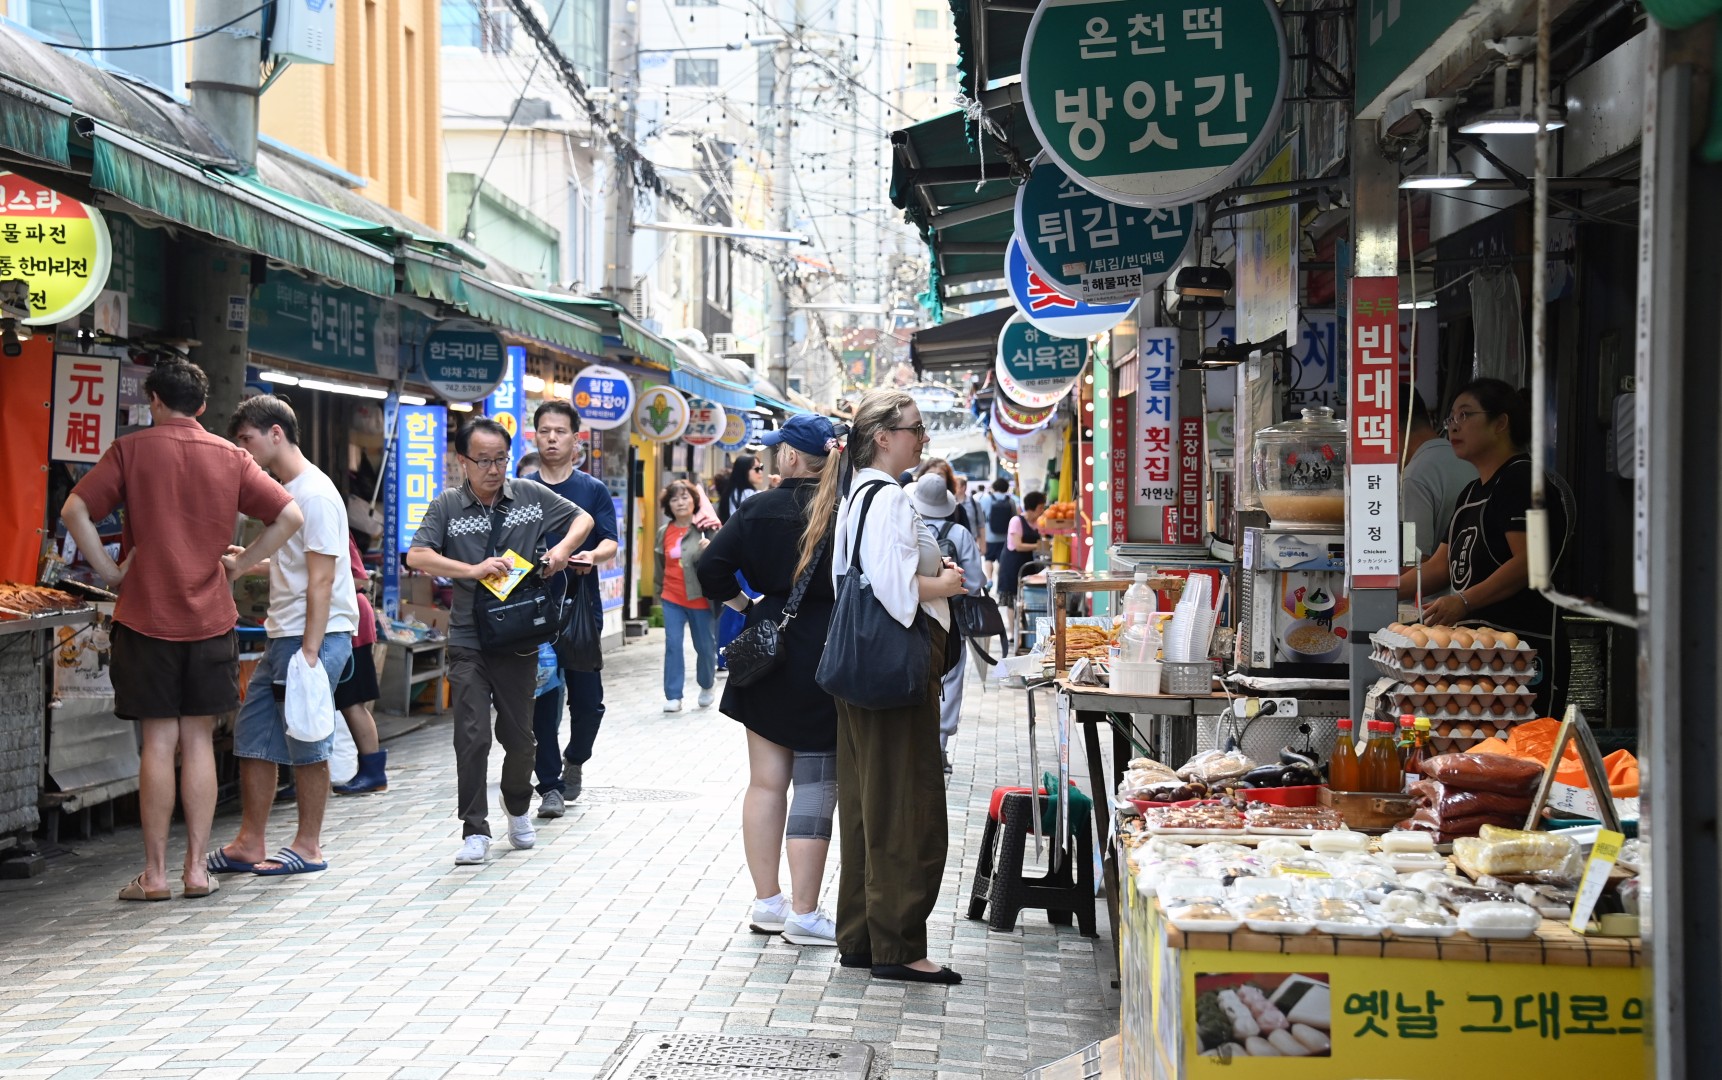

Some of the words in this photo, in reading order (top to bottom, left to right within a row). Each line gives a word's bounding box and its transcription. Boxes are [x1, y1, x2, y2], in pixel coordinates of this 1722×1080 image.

[1055, 73, 1253, 161] 방앗간
[18, 256, 88, 278] 한마리전
[1091, 274, 1142, 291] 해물파전
[311, 290, 366, 357] 한국마트
[1356, 297, 1395, 318] 녹두
[429, 341, 499, 361] 한국마트
[1024, 328, 1062, 343] 하
[1011, 344, 1080, 372] 식육점
[1357, 324, 1393, 455] 빈대떡
[66, 363, 104, 455] 元祖
[405, 412, 437, 531] 한국마트
[1114, 449, 1126, 472] 35년
[1114, 479, 1125, 502] 전통
[1141, 487, 1175, 500] 자연산
[1183, 422, 1199, 539] 포장해드립니다
[1366, 474, 1382, 542] 닭강정
[387, 537, 397, 576] 한국마트
[1343, 990, 1445, 1038] 옛날
